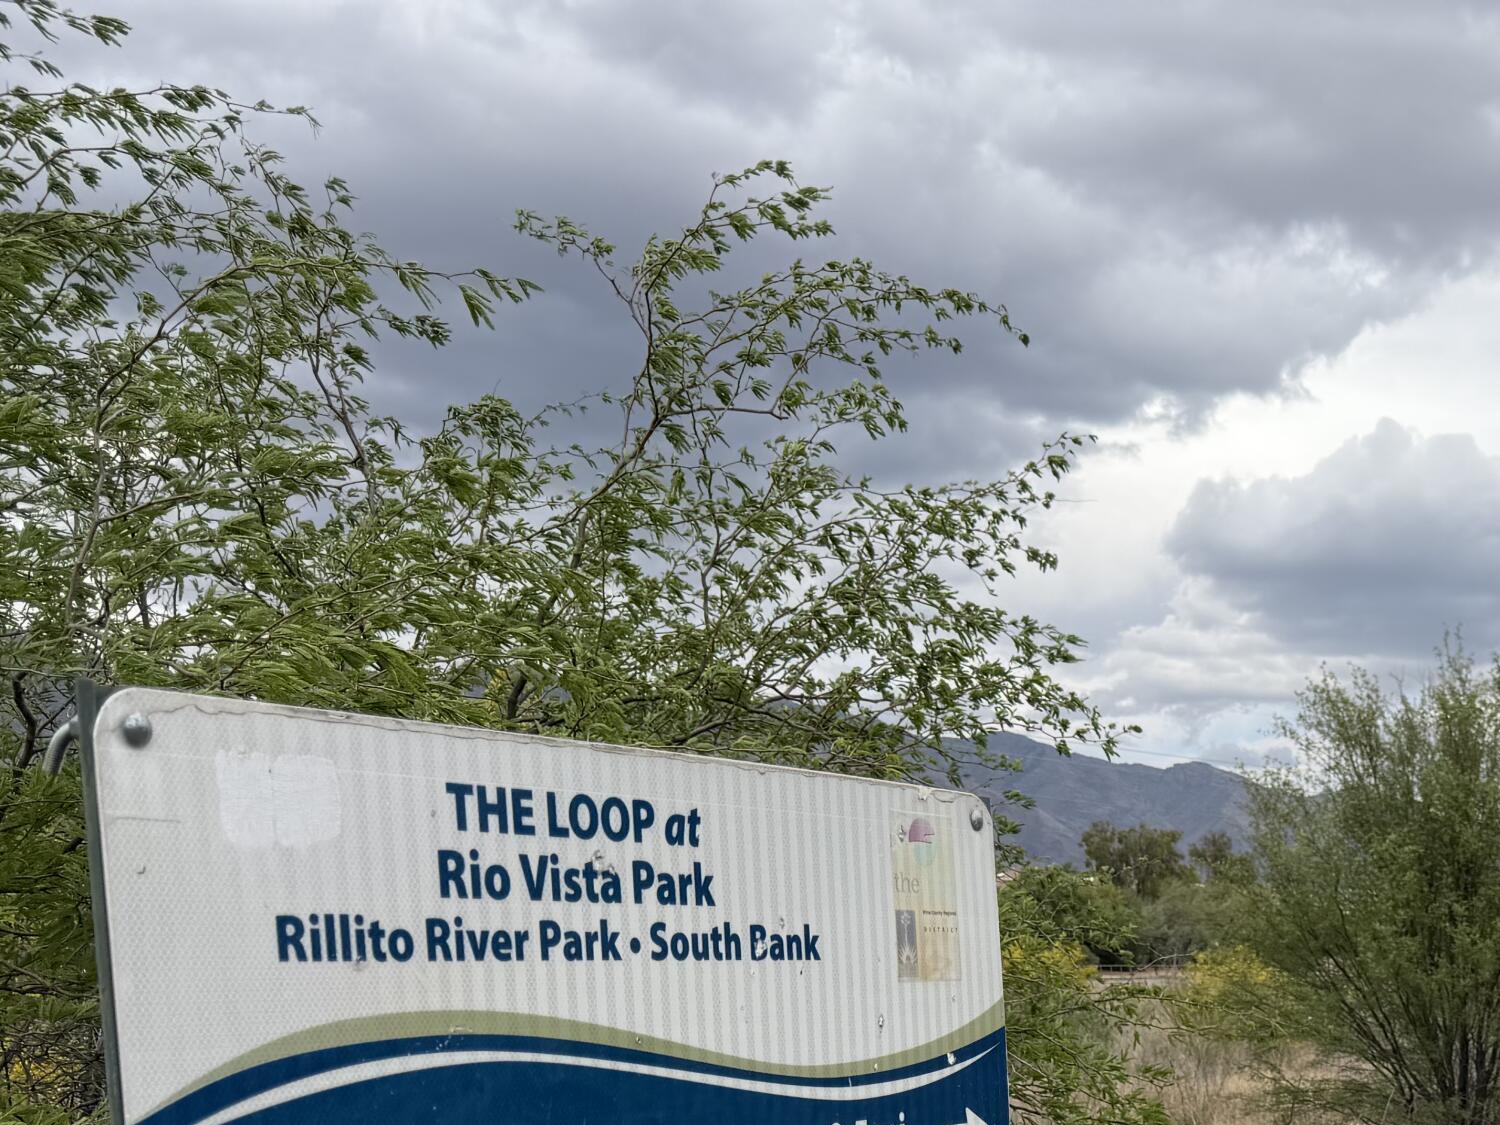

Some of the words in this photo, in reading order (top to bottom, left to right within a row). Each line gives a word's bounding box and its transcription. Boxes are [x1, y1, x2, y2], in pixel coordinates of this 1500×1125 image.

[445, 781, 536, 836] THE
[546, 791, 655, 844] LOOP
[664, 808, 701, 848] at
[437, 848, 511, 900] Rio
[518, 853, 622, 904] Vista
[632, 860, 716, 907] Park
[275, 913, 414, 962] Rillito
[425, 916, 529, 961] River
[538, 919, 623, 961] Park
[649, 922, 742, 961] South
[749, 924, 821, 961] Bank
